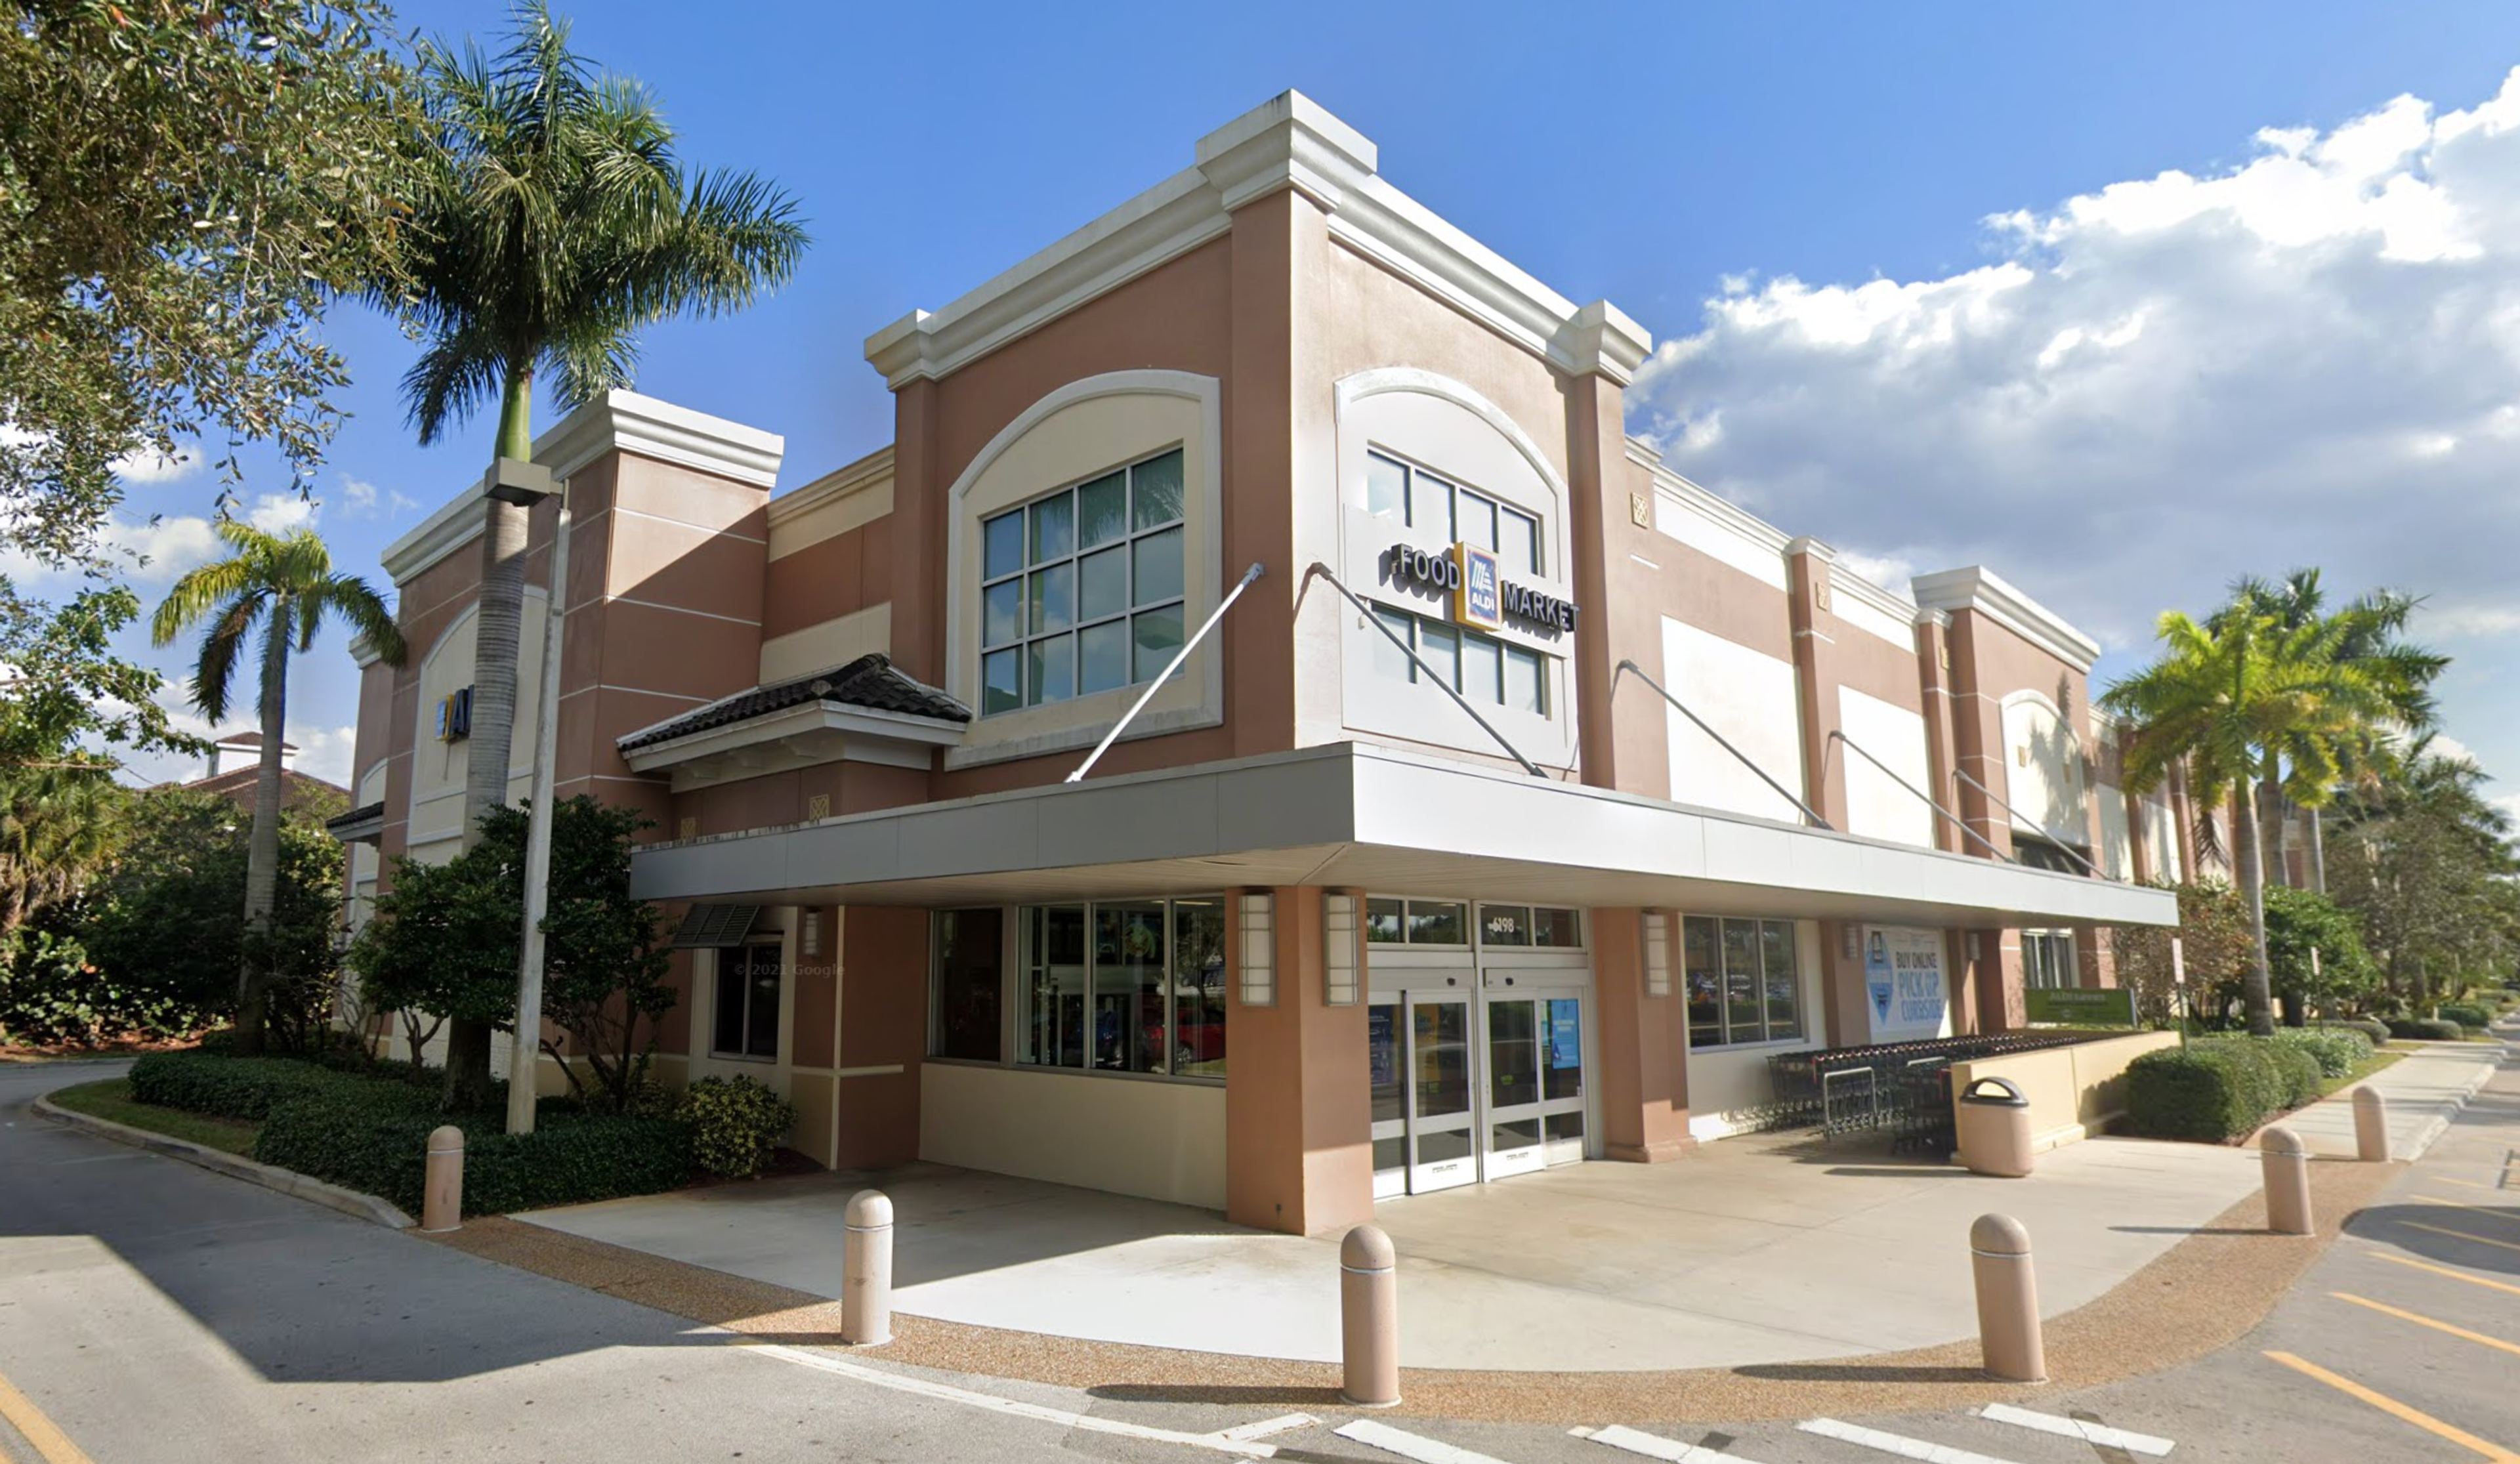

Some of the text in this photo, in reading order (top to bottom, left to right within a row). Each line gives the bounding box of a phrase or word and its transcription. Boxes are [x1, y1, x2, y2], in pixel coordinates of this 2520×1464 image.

[1396, 544, 1460, 591] FOOD
[1471, 591, 1495, 611] ALDI
[1502, 580, 1580, 632] MARKET
[1895, 952, 1938, 969] BUY ONLINE
[1897, 972, 1924, 998] PICK
[1900, 998, 1942, 1022] CURBSIDE
